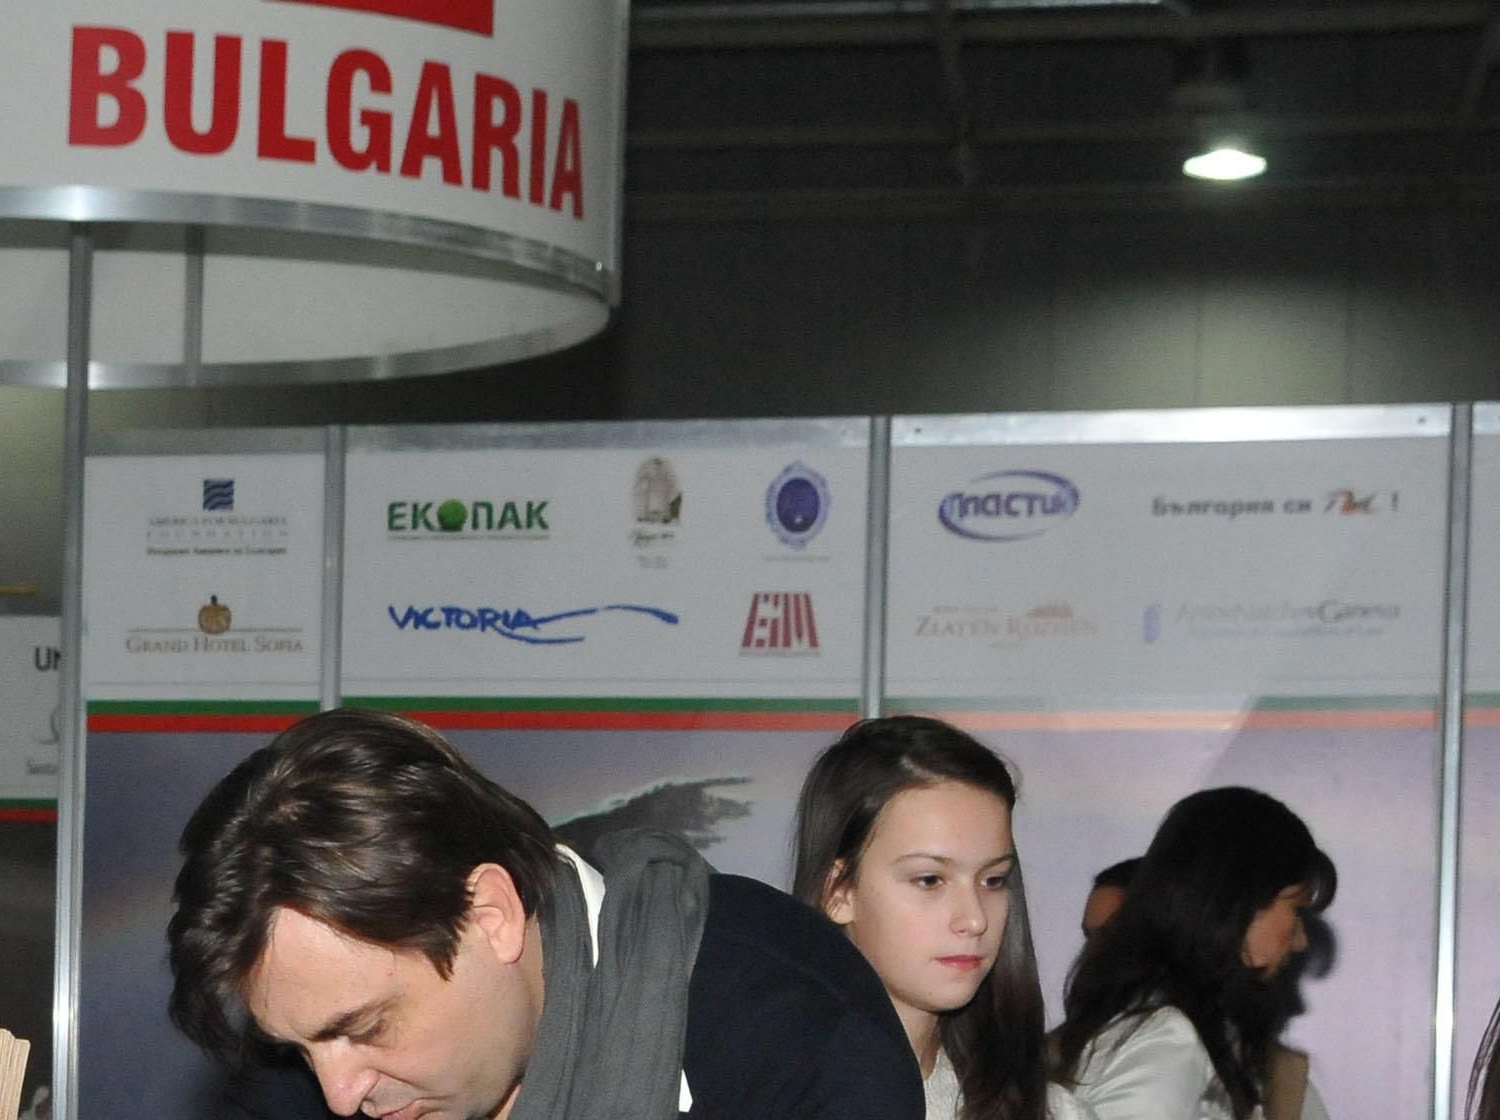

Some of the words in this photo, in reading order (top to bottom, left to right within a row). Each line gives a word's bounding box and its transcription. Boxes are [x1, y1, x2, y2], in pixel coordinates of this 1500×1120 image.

[68, 25, 584, 221] BULGARIA
[126, 635, 189, 653] GRAND
[193, 635, 251, 653] HOTEL
